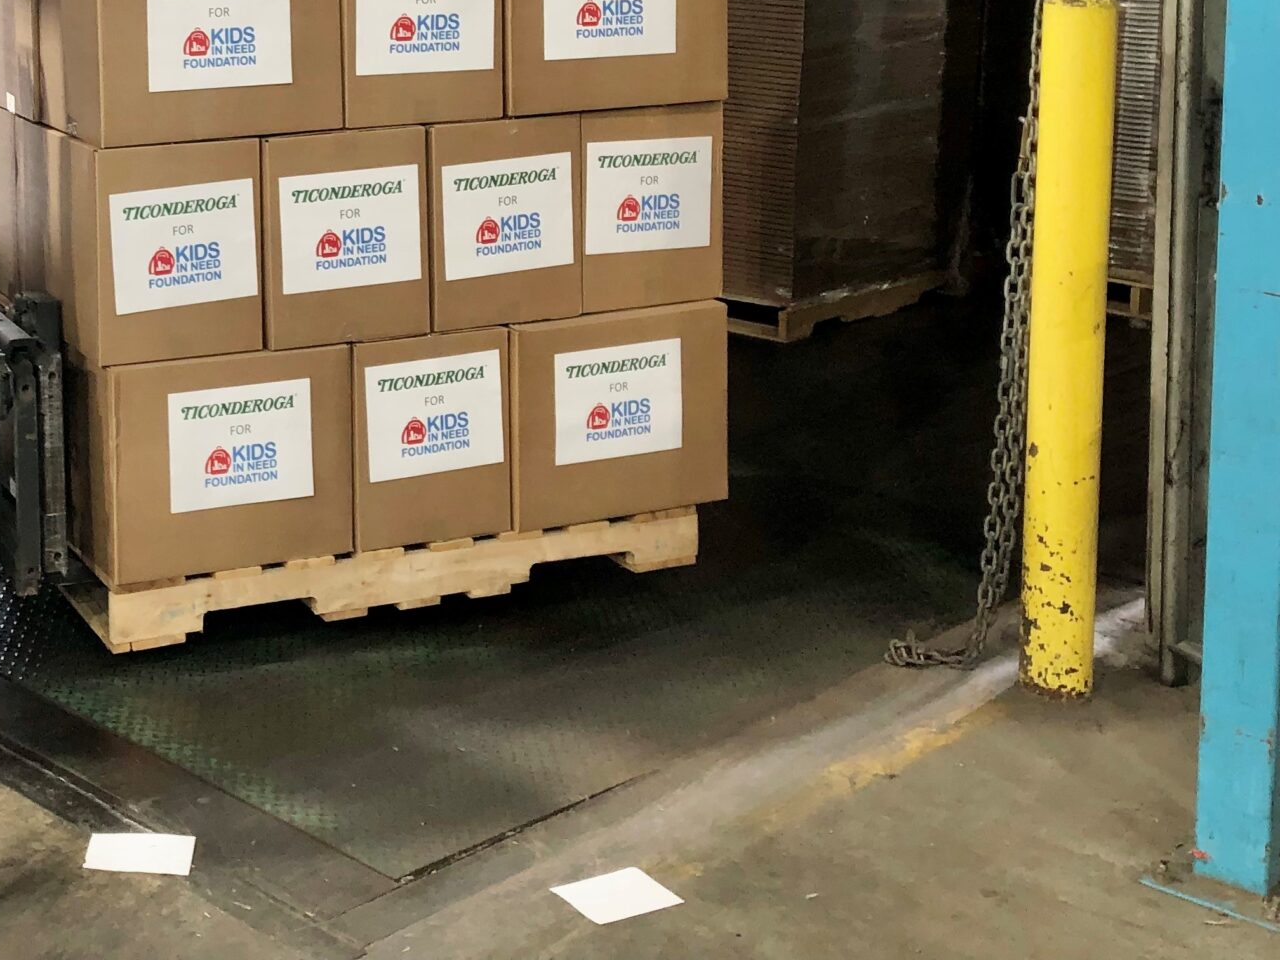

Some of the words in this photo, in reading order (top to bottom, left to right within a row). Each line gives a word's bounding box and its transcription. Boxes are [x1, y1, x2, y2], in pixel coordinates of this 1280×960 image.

[208, 7, 230, 18] FOR
[417, 13, 460, 31] KIDS
[602, 17, 613, 26] IN
[616, 15, 643, 25] NEED
[211, 26, 256, 45] KIDS
[417, 32, 428, 41] IN
[431, 30, 460, 40] NEED
[576, 26, 644, 38] FOUNDATION
[211, 46, 223, 55] IN
[226, 44, 256, 54] NEED
[389, 41, 460, 53] FOUNDATION
[183, 55, 256, 69] FOUNDATION
[598, 150, 697, 169] TICONDEROGA
[454, 167, 557, 193] TICONDEROGA
[640, 175, 659, 186] FOR
[291, 180, 403, 205] TICONDEROGA
[122, 194, 237, 222] TICONDEROGA
[498, 195, 518, 207] FOR
[641, 193, 680, 211] KIDS
[339, 208, 361, 220] FOR
[641, 212, 651, 220] IN
[654, 210, 680, 220] NEED
[501, 212, 541, 232] KIDS
[616, 220, 680, 233] FOUNDATION
[172, 224, 194, 236] FOR
[342, 225, 386, 246] KIDS
[501, 232, 511, 242] IN
[514, 229, 541, 240] NEED
[175, 241, 221, 263] KIDS
[343, 246, 354, 256] IN
[357, 243, 386, 254] NEED
[476, 239, 542, 257] FOUNDATION
[176, 263, 188, 273] IN
[191, 259, 221, 271] NEED
[316, 254, 387, 271] FOUNDATION
[148, 270, 222, 289] FOUNDATION
[566, 353, 667, 380] TICONDEROGA
[377, 365, 485, 394] TICONDEROGA
[609, 381, 628, 393] FOR
[181, 394, 295, 421] TICONDEROGA
[424, 394, 445, 407] FOR
[611, 397, 651, 418] KIDS
[427, 411, 469, 433] KIDS
[611, 418, 621, 428] IN
[624, 414, 651, 426] NEED
[230, 423, 252, 436] FOR
[428, 432, 438, 442] IN
[441, 428, 469, 440] NEED
[586, 424, 651, 442] FOUNDATION
[232, 441, 277, 463] KIDS
[401, 438, 470, 458] FOUNDATION
[233, 463, 244, 473] IN
[247, 459, 277, 471] NEED
[205, 470, 278, 488] FOUNDATION
